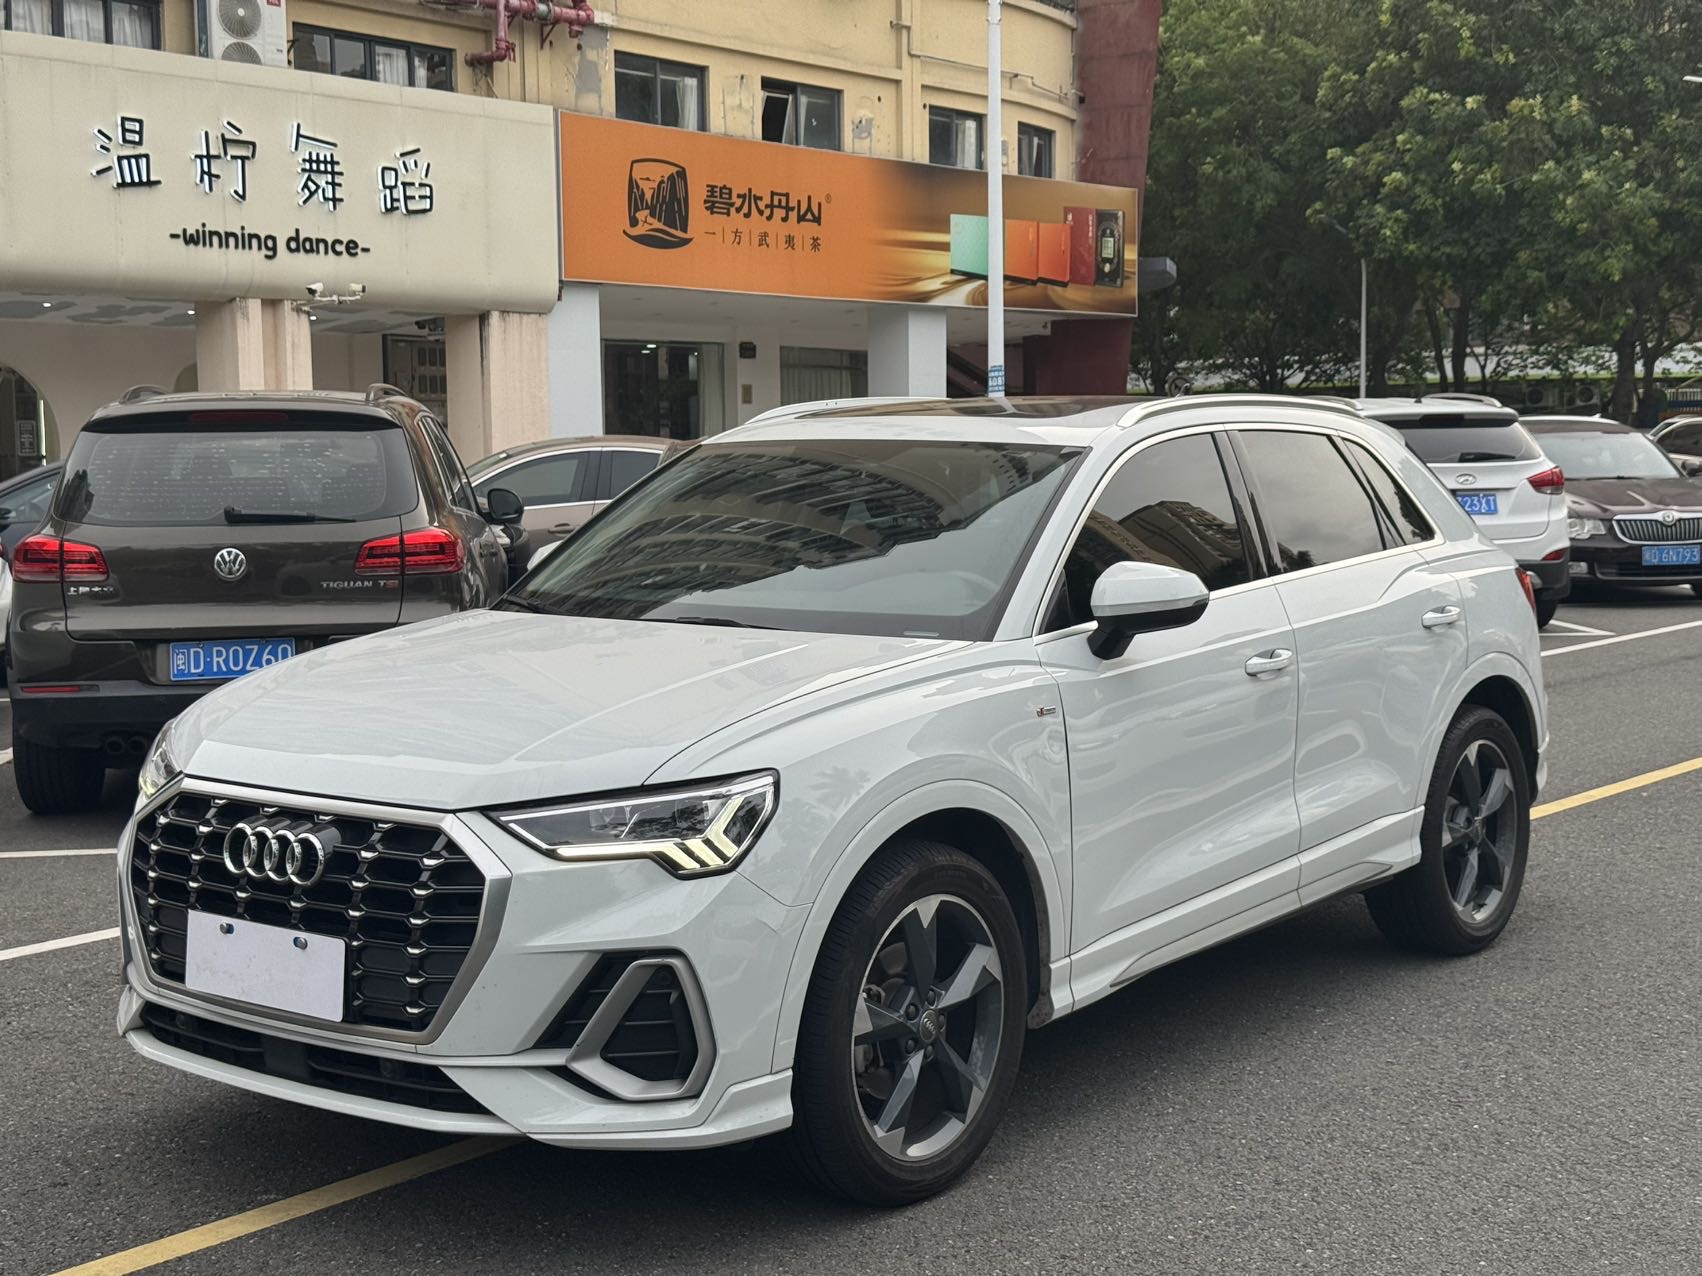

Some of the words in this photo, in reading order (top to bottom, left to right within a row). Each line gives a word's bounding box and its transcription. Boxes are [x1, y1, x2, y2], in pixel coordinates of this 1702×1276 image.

[90, 115, 434, 215] 温柠舞蹈
[703, 184, 822, 226] 碧水丹山
[320, 580, 373, 589] TIGUAN
